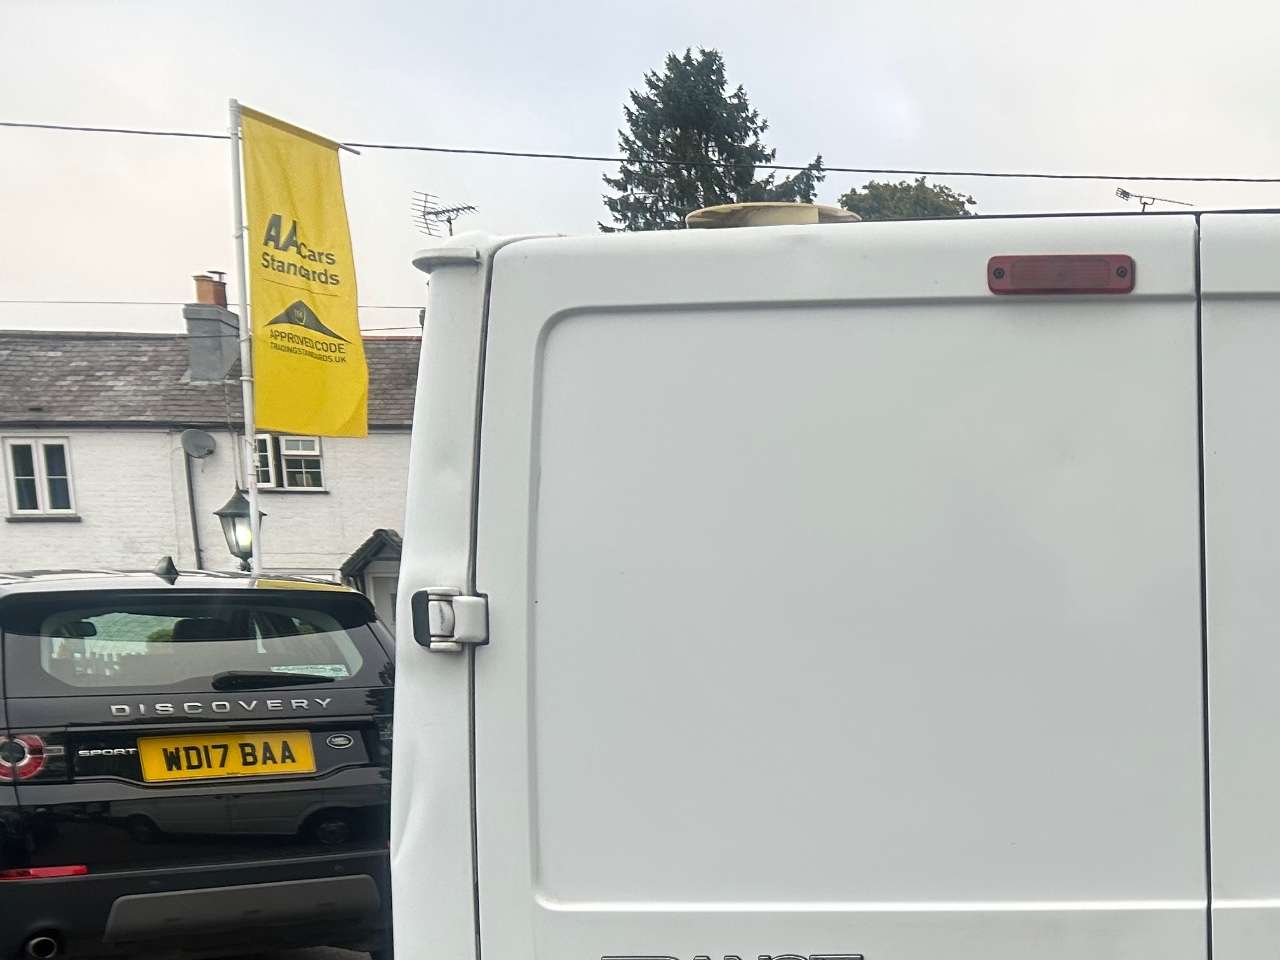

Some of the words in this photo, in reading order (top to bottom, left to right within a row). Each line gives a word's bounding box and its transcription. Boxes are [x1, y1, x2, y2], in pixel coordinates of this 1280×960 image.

[314, 341, 346, 354] CODE
[110, 698, 332, 716] DISCOVERY
[78, 748, 138, 757] SPORT
[162, 744, 229, 772] WD17
[238, 740, 297, 767] BAA
